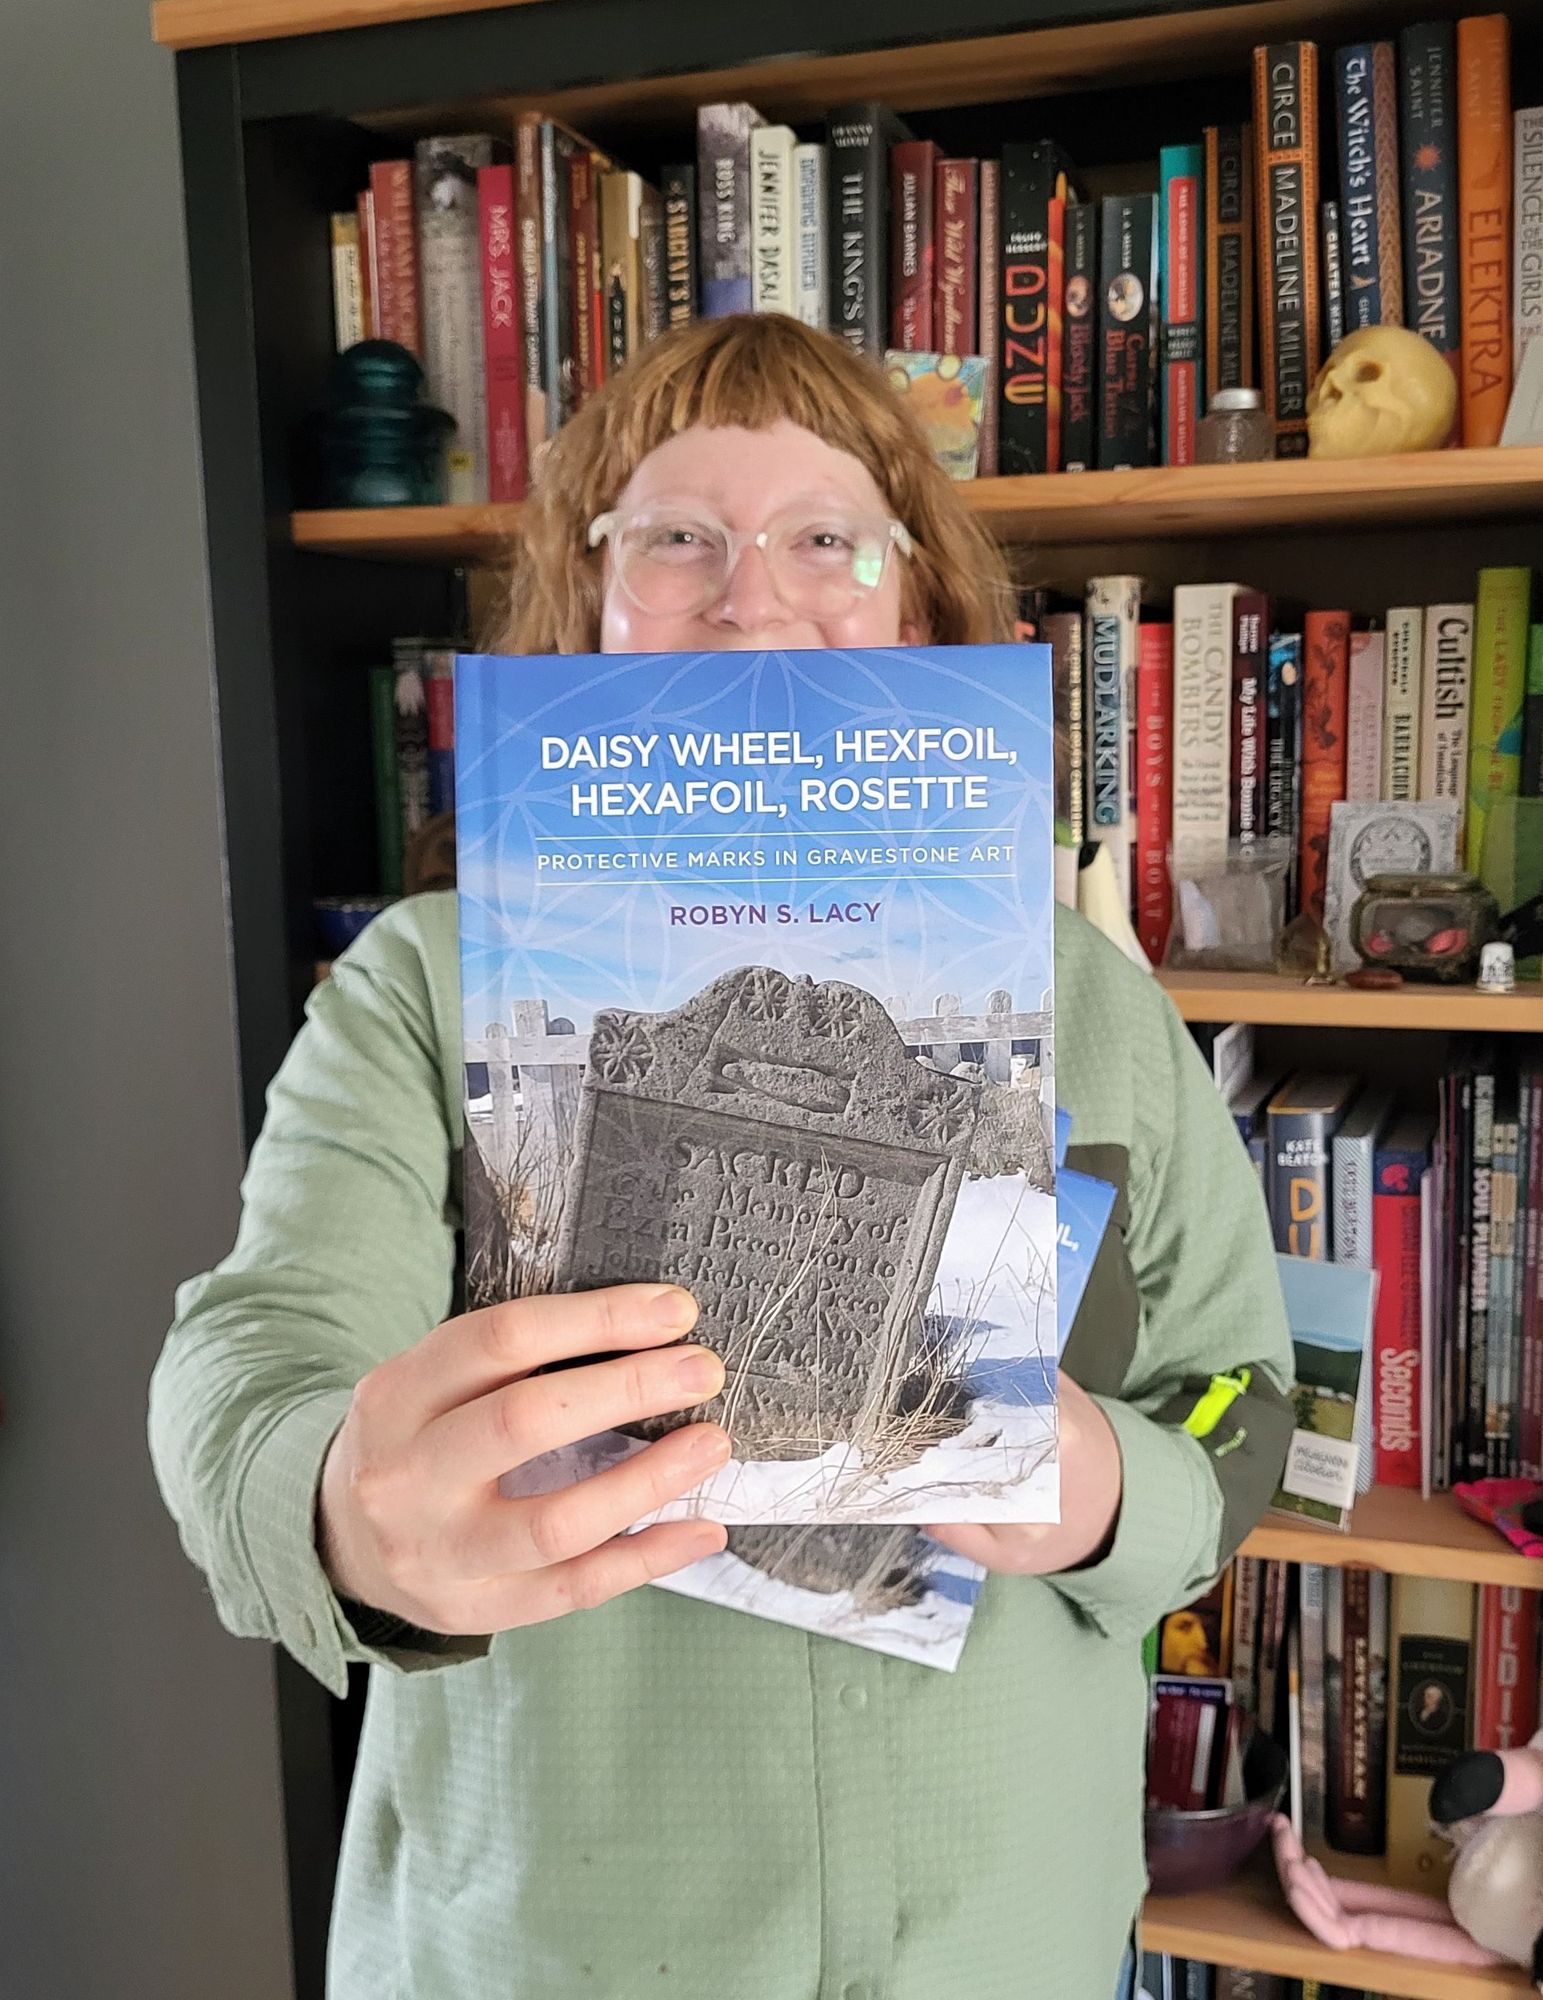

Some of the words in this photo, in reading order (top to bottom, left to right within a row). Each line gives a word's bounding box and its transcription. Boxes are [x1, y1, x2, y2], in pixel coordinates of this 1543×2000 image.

[1271, 61, 1296, 147] CIRCE
[1344, 57, 1367, 95] The
[1408, 65, 1424, 120] SAINT
[1346, 95, 1373, 188] Witch's
[716, 159, 736, 200] ROSS
[758, 149, 781, 237] JENNIFER
[842, 171, 865, 224] THE
[903, 173, 917, 220] JULIAN
[1521, 131, 1543, 225] SILENCE
[716, 202, 736, 243] KING
[903, 222, 917, 277] BARNES
[944, 219, 966, 262] Wild
[1274, 168, 1299, 312] MADELINE
[1347, 194, 1372, 266] Heart
[758, 246, 781, 303] DASAL
[842, 231, 866, 321] KING'S
[1413, 189, 1446, 340] ARIADNE
[1520, 252, 1543, 318] GIRLS
[488, 267, 514, 329] JACK
[1467, 208, 1503, 398] ELEKTRA
[1105, 328, 1127, 376] Blue
[1278, 321, 1302, 415] MILLER
[1180, 617, 1202, 750] BOMBERS
[1203, 645, 1225, 749] CANDY
[1434, 617, 1470, 720] Cultish
[541, 734, 658, 770] DAISY
[669, 730, 824, 769] WHEEL,
[835, 726, 1018, 766] HEXFOIL,
[1092, 615, 1120, 825] MUDLARKING
[1241, 705, 1257, 736] Life
[1146, 715, 1165, 788] BOYS
[1240, 736, 1257, 775] With
[571, 781, 787, 818] HEXAFOIL,
[801, 776, 989, 813] ROSETTE
[537, 852, 678, 871] PROTECTIVE
[688, 850, 766, 868] MARKS
[775, 849, 798, 866] IN
[807, 846, 960, 866] GRAVESTONE
[970, 844, 1014, 863] ART
[1145, 849, 1162, 920] BOAT
[670, 905, 767, 927] ROBYN
[776, 904, 800, 925] S.
[809, 902, 882, 924] LACY
[1286, 1138, 1321, 1153] KATE
[1472, 1167, 1490, 1218] SOUL
[1379, 1347, 1419, 1453] Seconds
